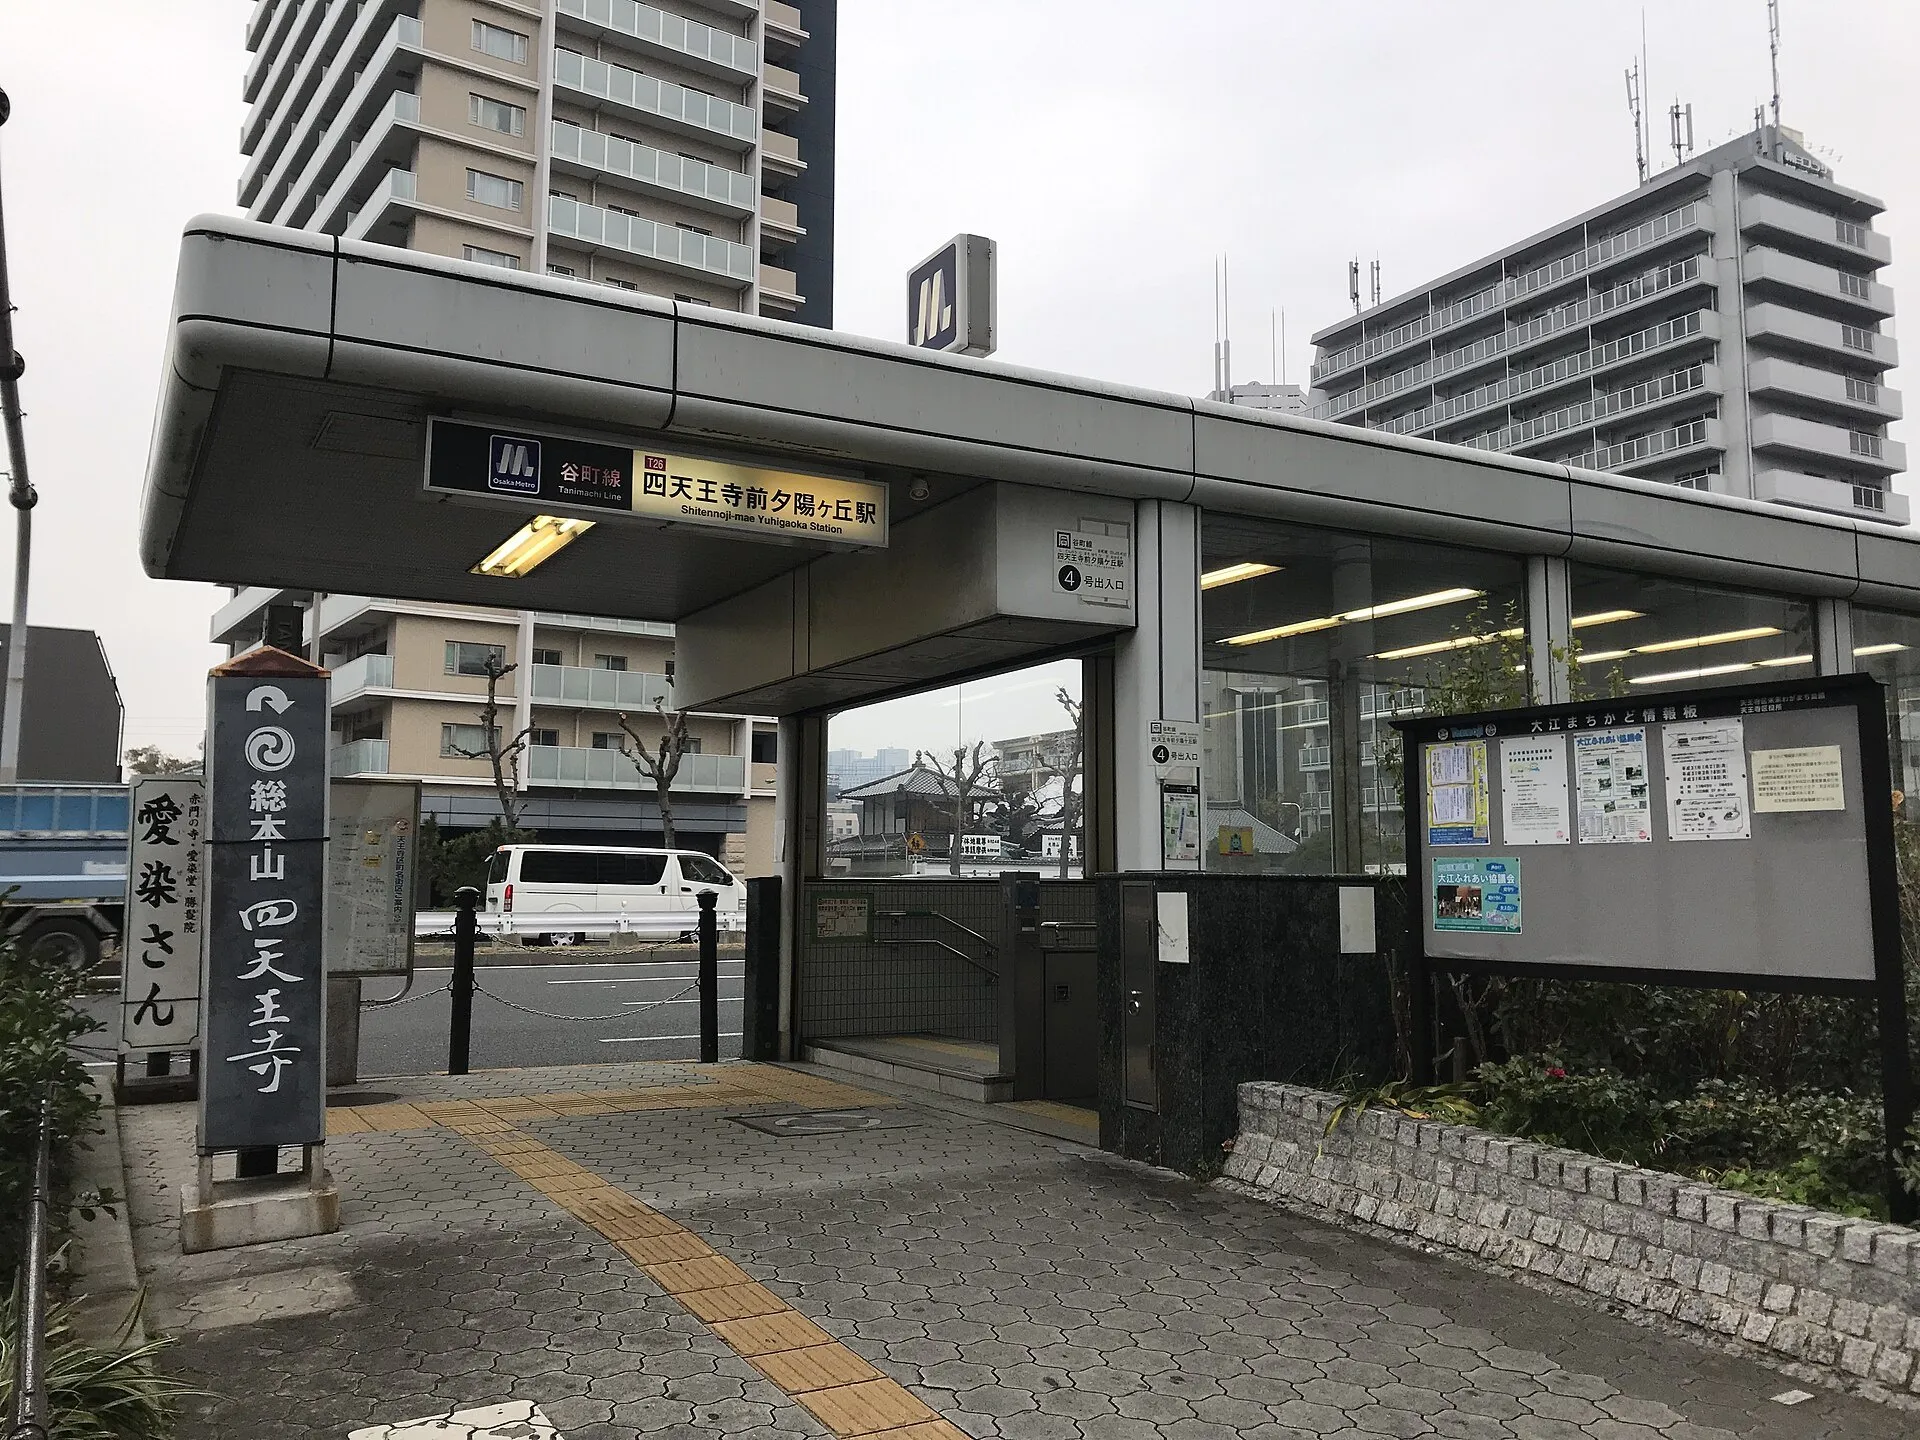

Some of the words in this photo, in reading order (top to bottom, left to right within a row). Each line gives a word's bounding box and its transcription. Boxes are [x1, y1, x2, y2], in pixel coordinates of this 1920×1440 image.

[647, 457, 664, 470] T26
[492, 477, 515, 487] Osaka
[515, 480, 536, 489] Metro
[560, 462, 621, 488] 谷町線
[558, 485, 602, 499] Tanimachi
[603, 491, 622, 501] Line
[643, 471, 876, 525] 四天王寺前夕陽ヶ丘駅
[681, 504, 755, 523] Shitennoji-mae
[757, 514, 808, 531] Yuhigaoka
[810, 521, 842, 535] Station
[1072, 538, 1093, 548] 谷町線
[1083, 575, 1124, 591] 号出入口
[1530, 704, 1698, 734] 大江まちかど情報板
[1170, 751, 1198, 761] 号出入口
[250, 779, 287, 881] 総本山
[1437, 873, 1515, 884] 大江ふれあい協議会
[134, 792, 183, 1027] 愛染さん
[225, 899, 303, 1094] 四天王寺
